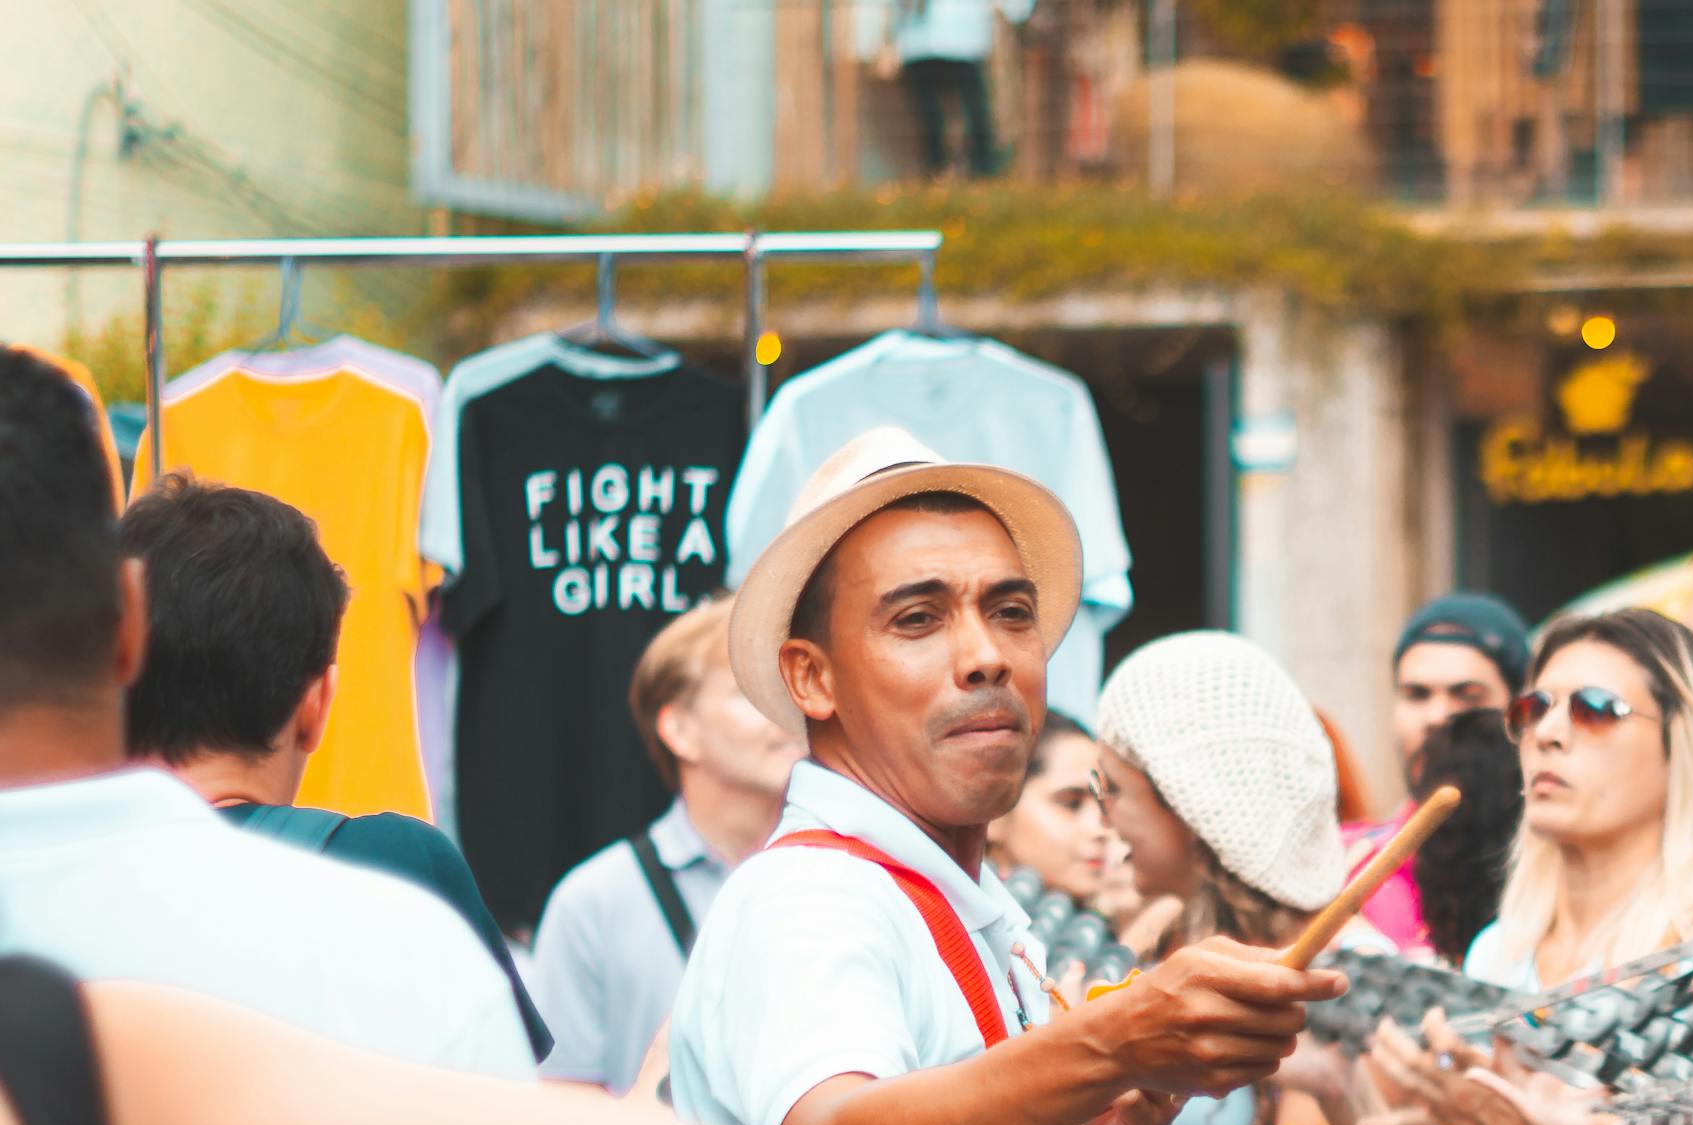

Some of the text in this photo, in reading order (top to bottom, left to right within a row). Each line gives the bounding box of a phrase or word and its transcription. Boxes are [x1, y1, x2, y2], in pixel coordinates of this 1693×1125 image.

[526, 463, 719, 521] FIGHT
[529, 514, 717, 569] LIKE A
